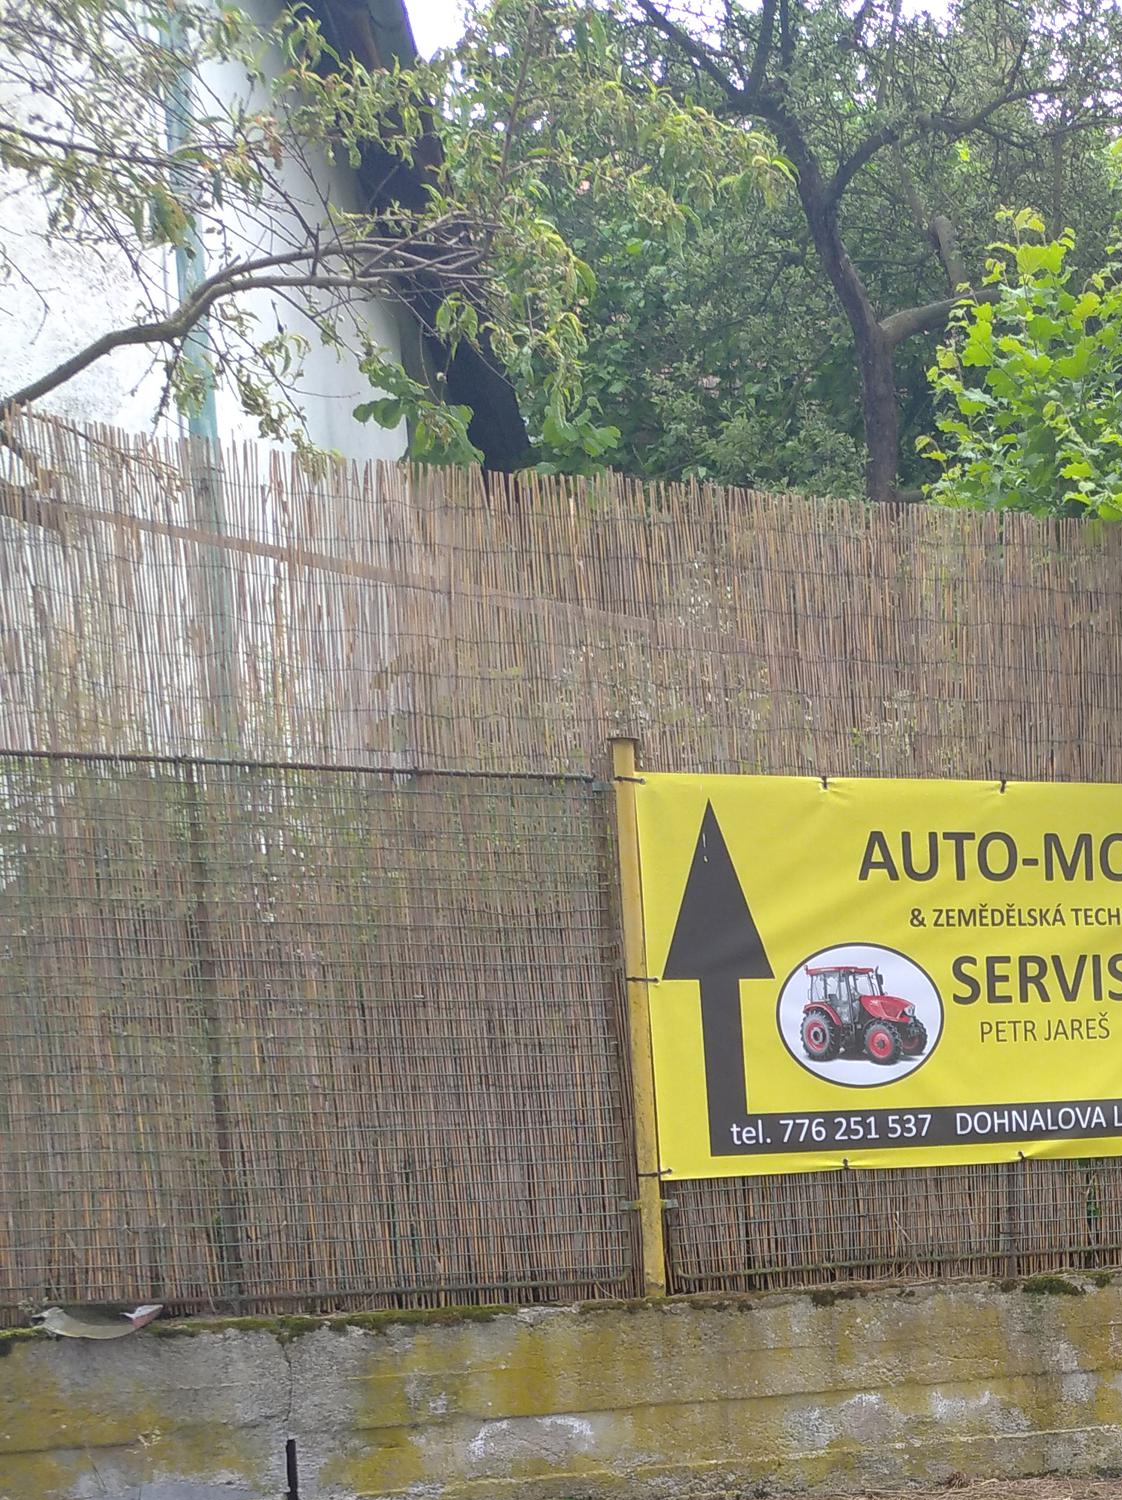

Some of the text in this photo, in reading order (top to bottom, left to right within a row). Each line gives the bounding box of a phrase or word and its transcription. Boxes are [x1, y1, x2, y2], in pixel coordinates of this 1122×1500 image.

[909, 907, 927, 928] &
[932, 903, 1066, 928] ZEMĚDĚLSKÁ
[980, 1011, 1110, 1043] PETR JAREŠ
[730, 1119, 772, 1145] tel.
[779, 1118, 827, 1143] 776
[834, 1115, 880, 1141] 251
[887, 1113, 932, 1138] 537
[955, 1106, 1107, 1135] DOHNALOVA
